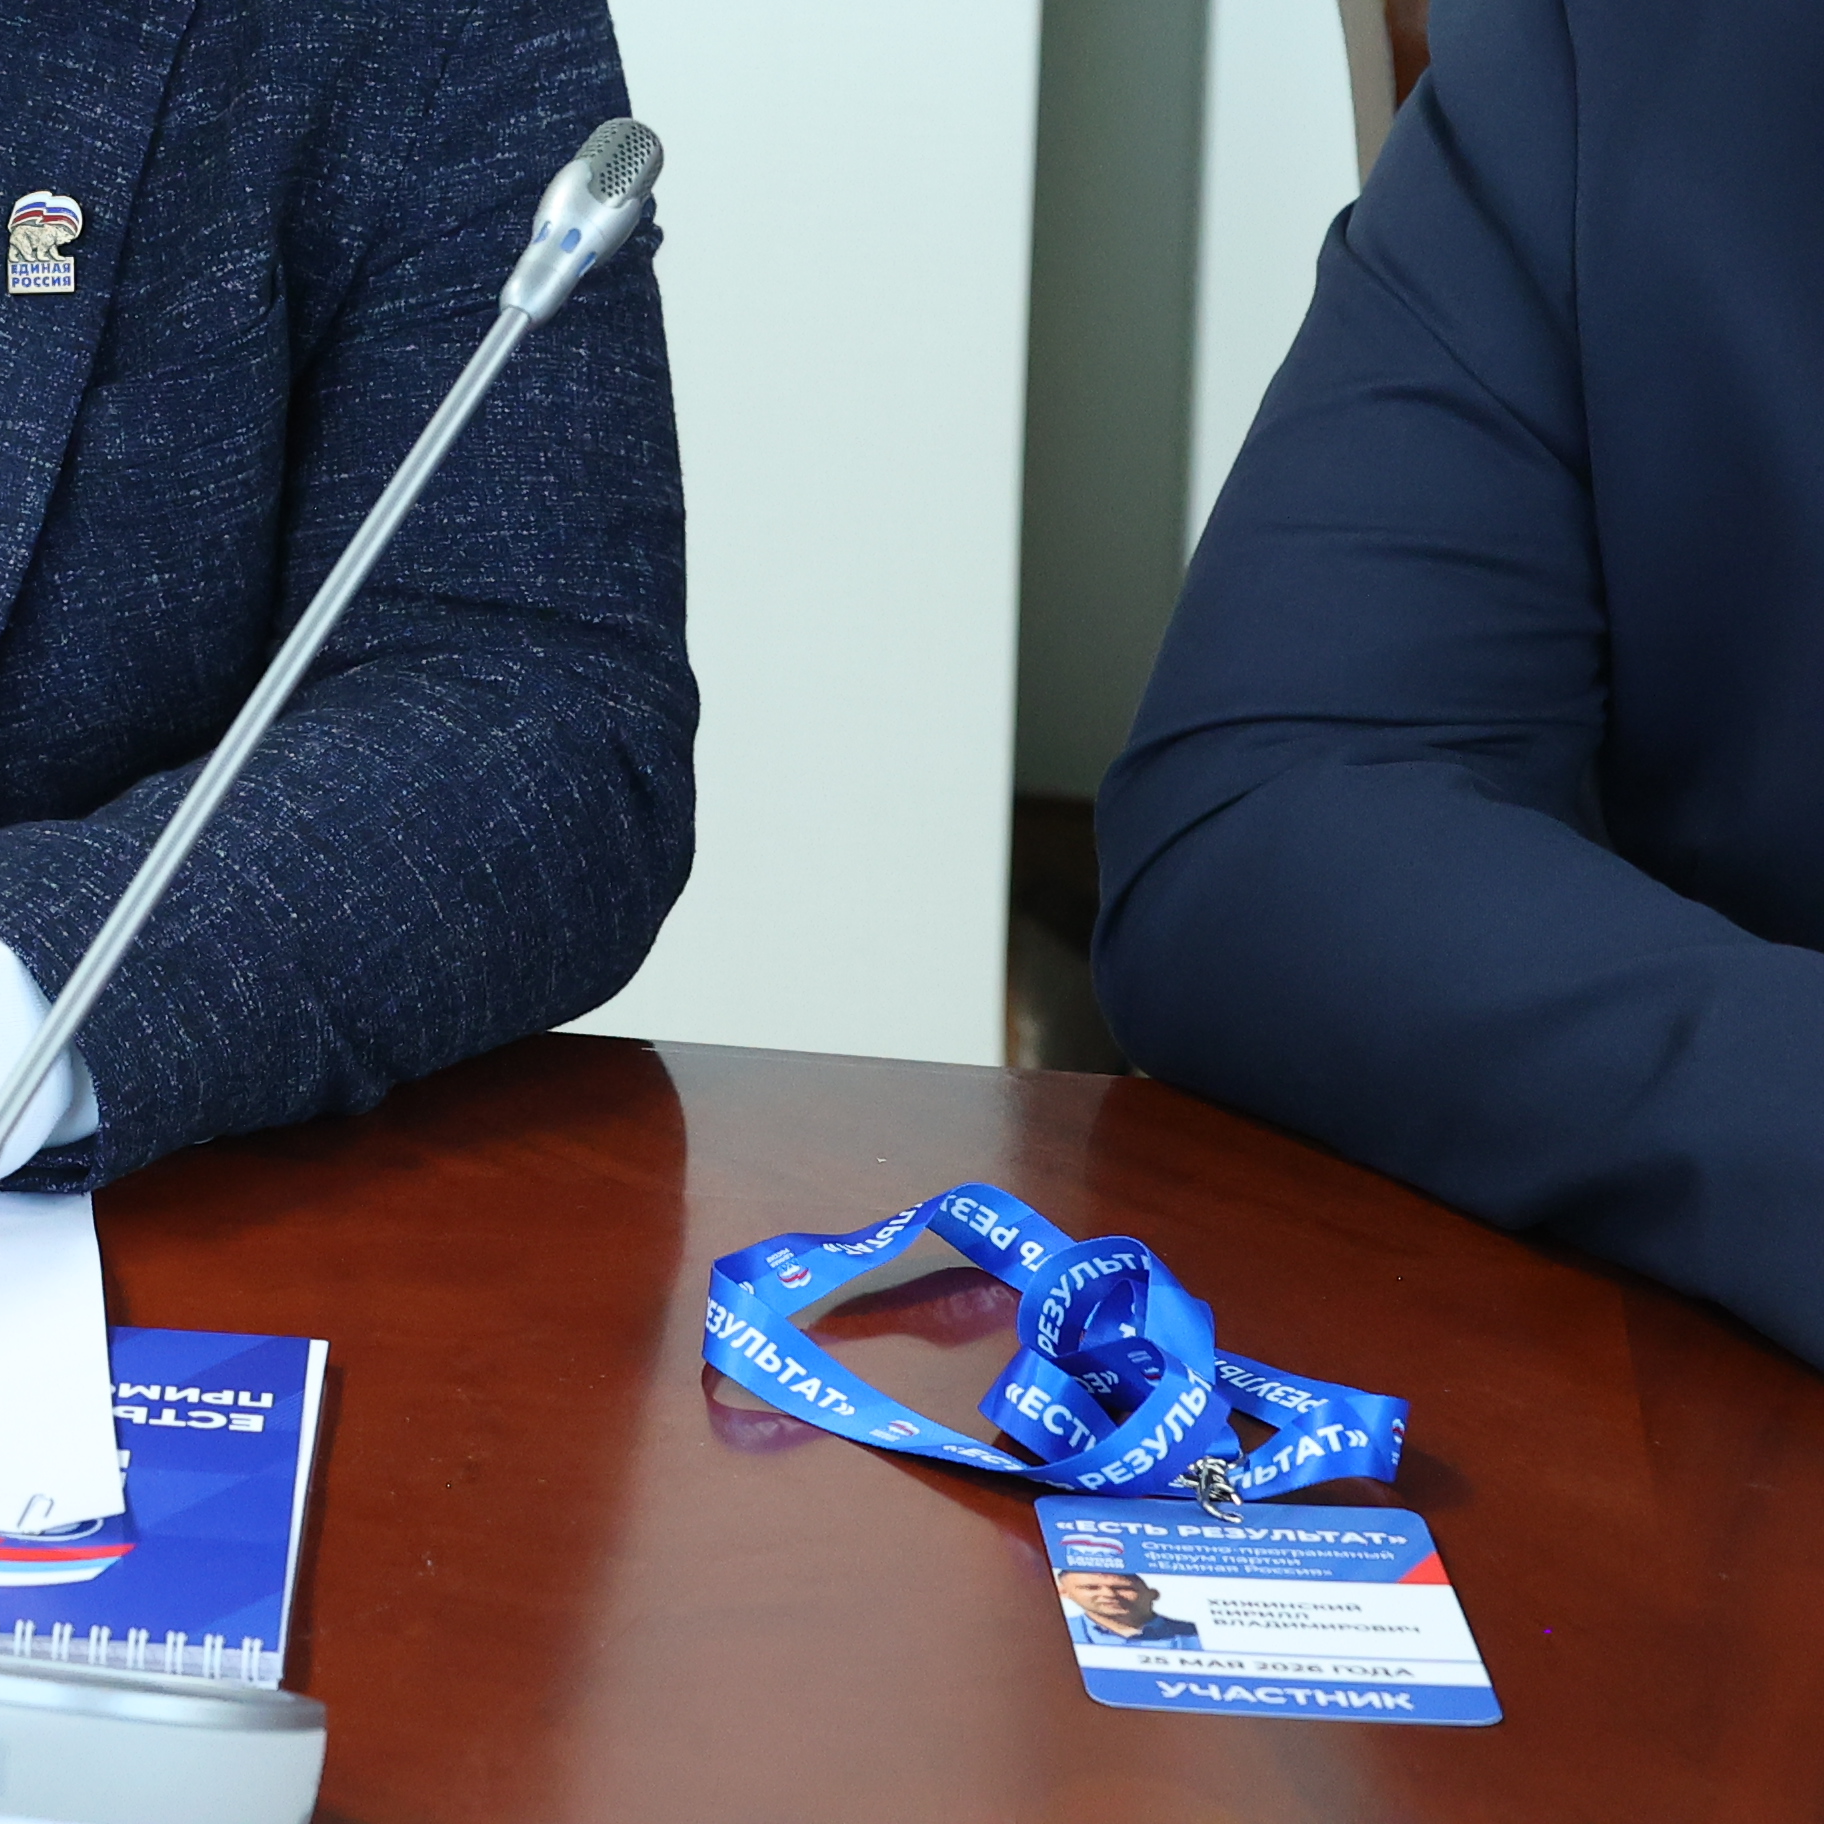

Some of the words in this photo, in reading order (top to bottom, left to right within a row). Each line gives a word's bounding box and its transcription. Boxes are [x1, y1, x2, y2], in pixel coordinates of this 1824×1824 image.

[11, 263, 71, 276] ЕДИНАЯ
[12, 277, 71, 288] РОССИЯ
[113, 1404, 265, 1433] ЕСТЬ
[1055, 1518, 1168, 1539] «ЕСТЬ
[1178, 1524, 1409, 1547] РЕЗУЛЬТАТ»
[1207, 1597, 1363, 1613] ХИЖИНСКИЙ
[1209, 1608, 1310, 1621] КИРИЛЛ
[1212, 1618, 1421, 1636] ВЛАДИМИРОВИЧ
[1138, 1654, 1170, 1666] 25
[1179, 1656, 1247, 1671] МАЯ
[1255, 1660, 1324, 1675] 2026
[1331, 1664, 1415, 1679] ГОДА
[1155, 1679, 1415, 1712] УЧАСТНИК
